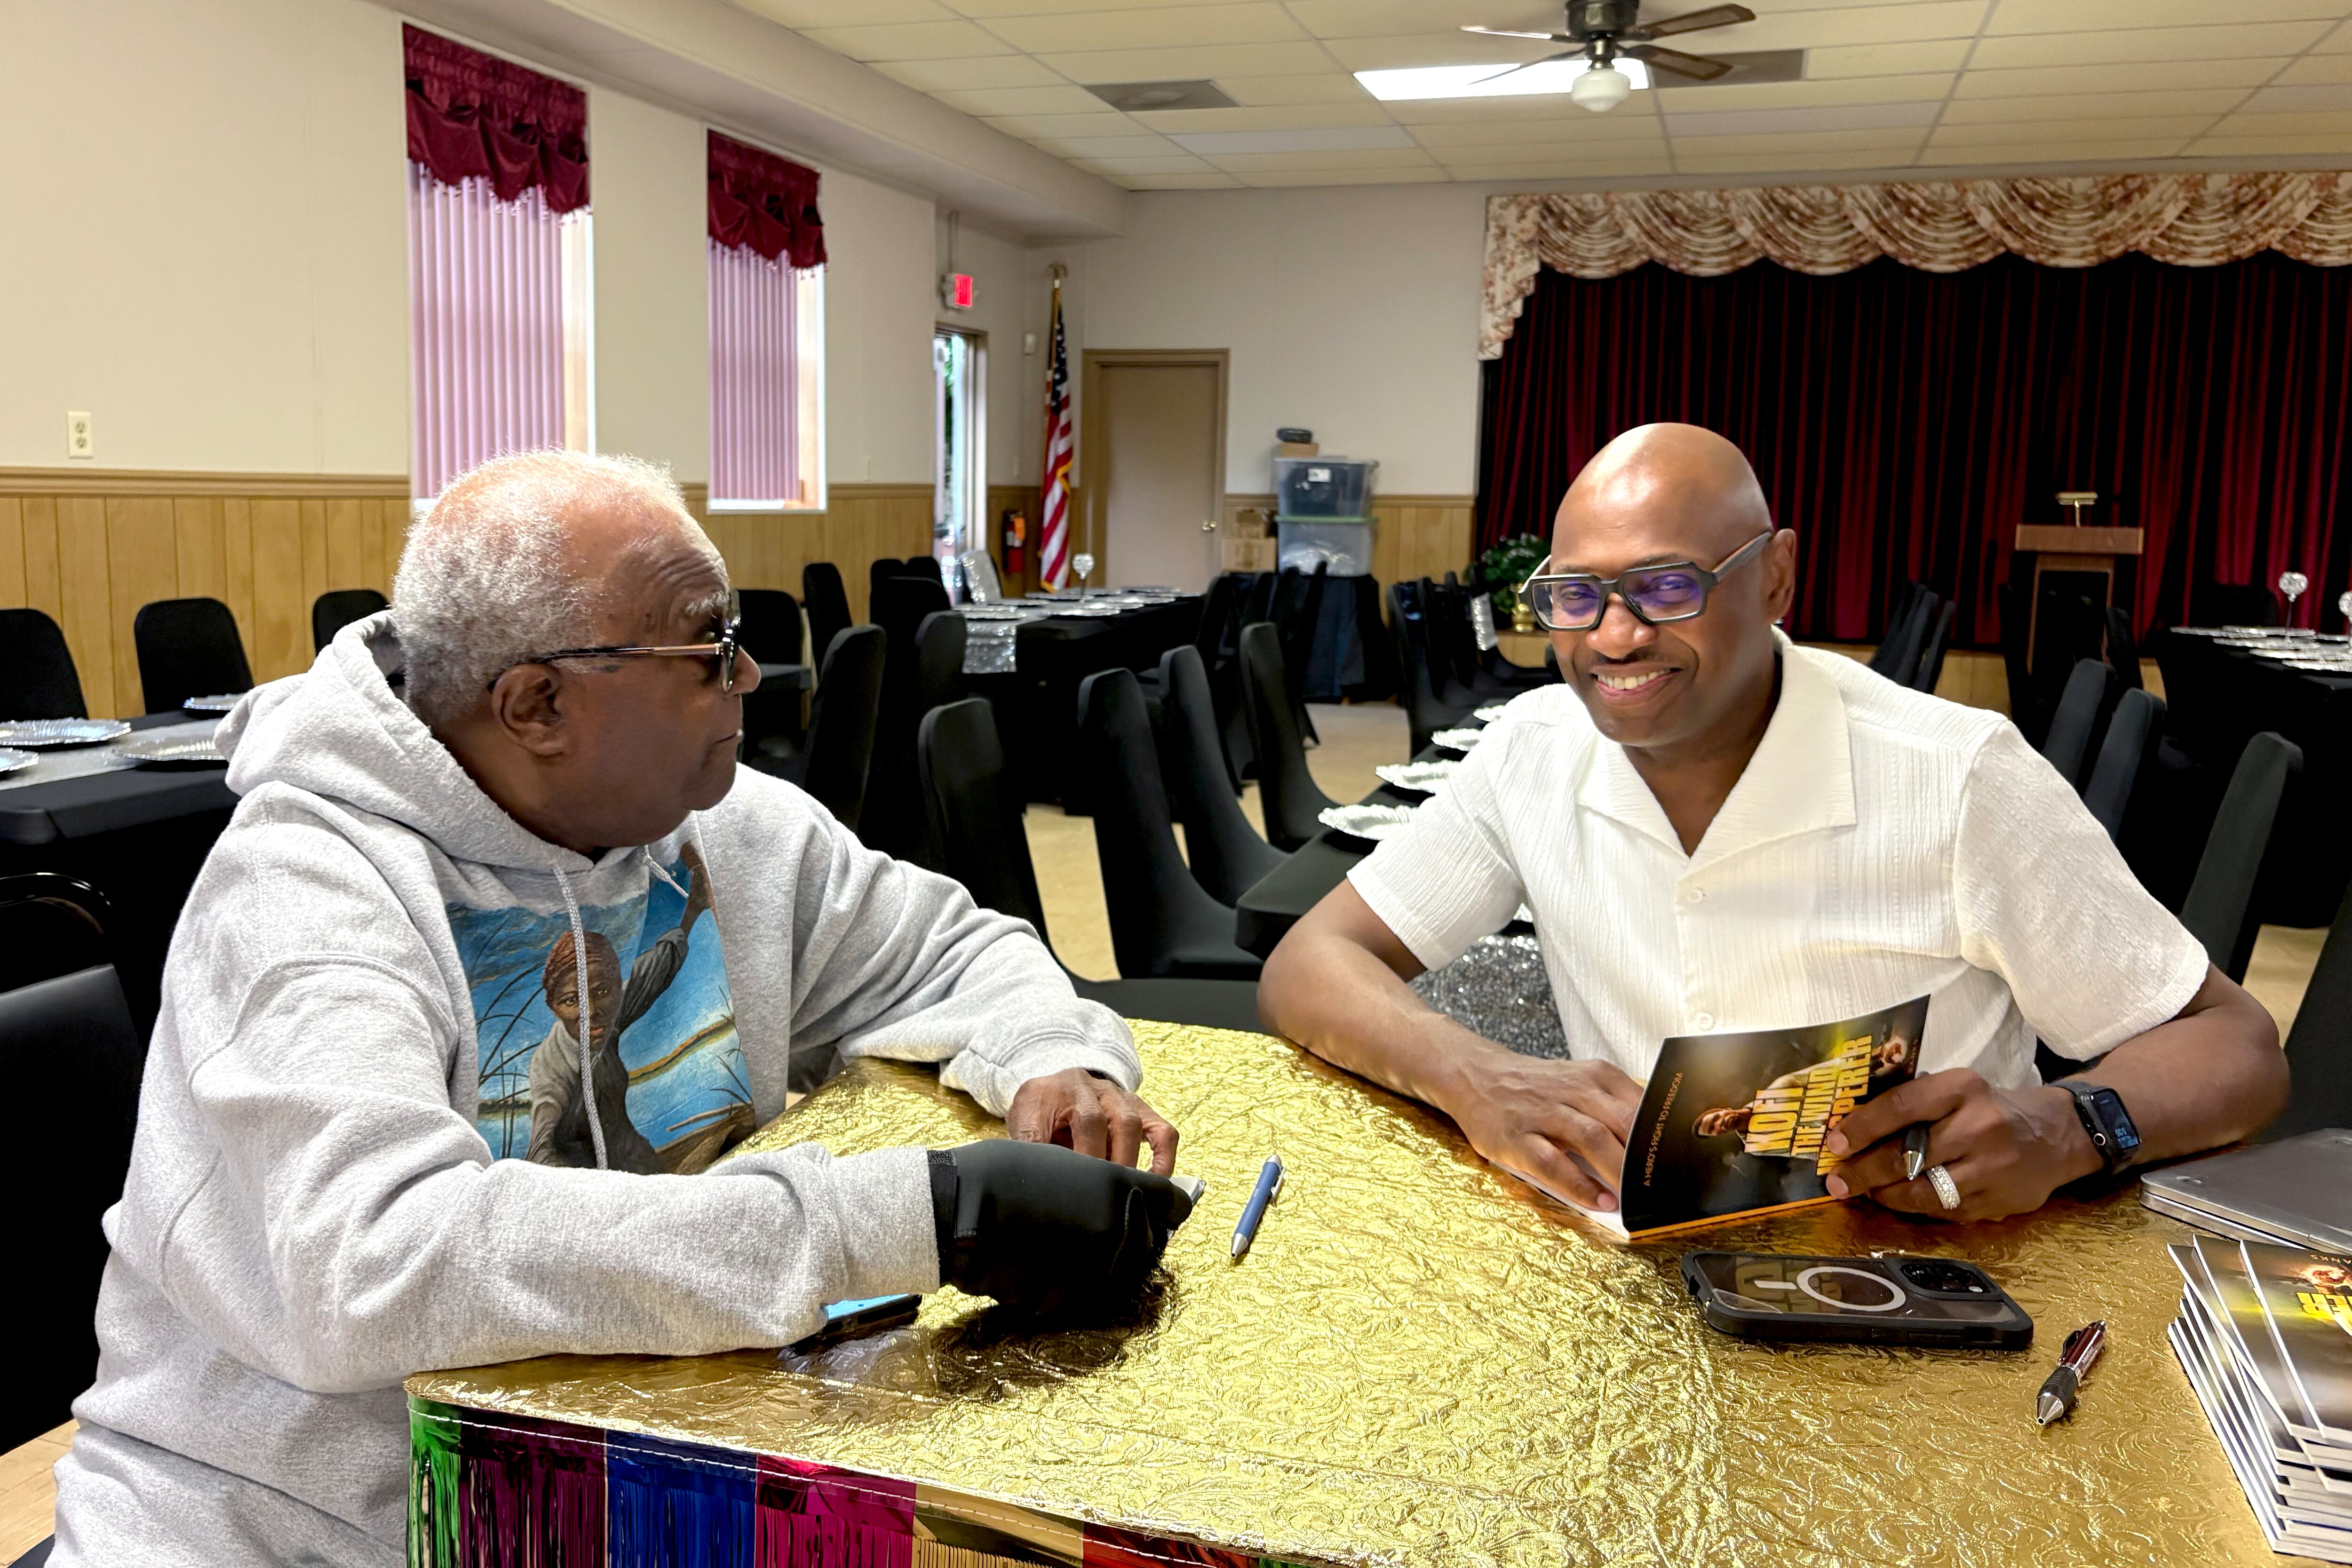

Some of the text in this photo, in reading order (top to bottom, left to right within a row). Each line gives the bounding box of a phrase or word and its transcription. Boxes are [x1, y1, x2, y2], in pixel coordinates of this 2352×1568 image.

[1663, 1072, 1683, 1110] FREEDOM
[1659, 1110, 1669, 1122] TO
[1744, 1087, 1804, 1153] KOFI
[1791, 1067, 1836, 1156] THE WIND
[1652, 1122, 1664, 1146] FIGHT
[1645, 1146, 1657, 1178] HERO'S
